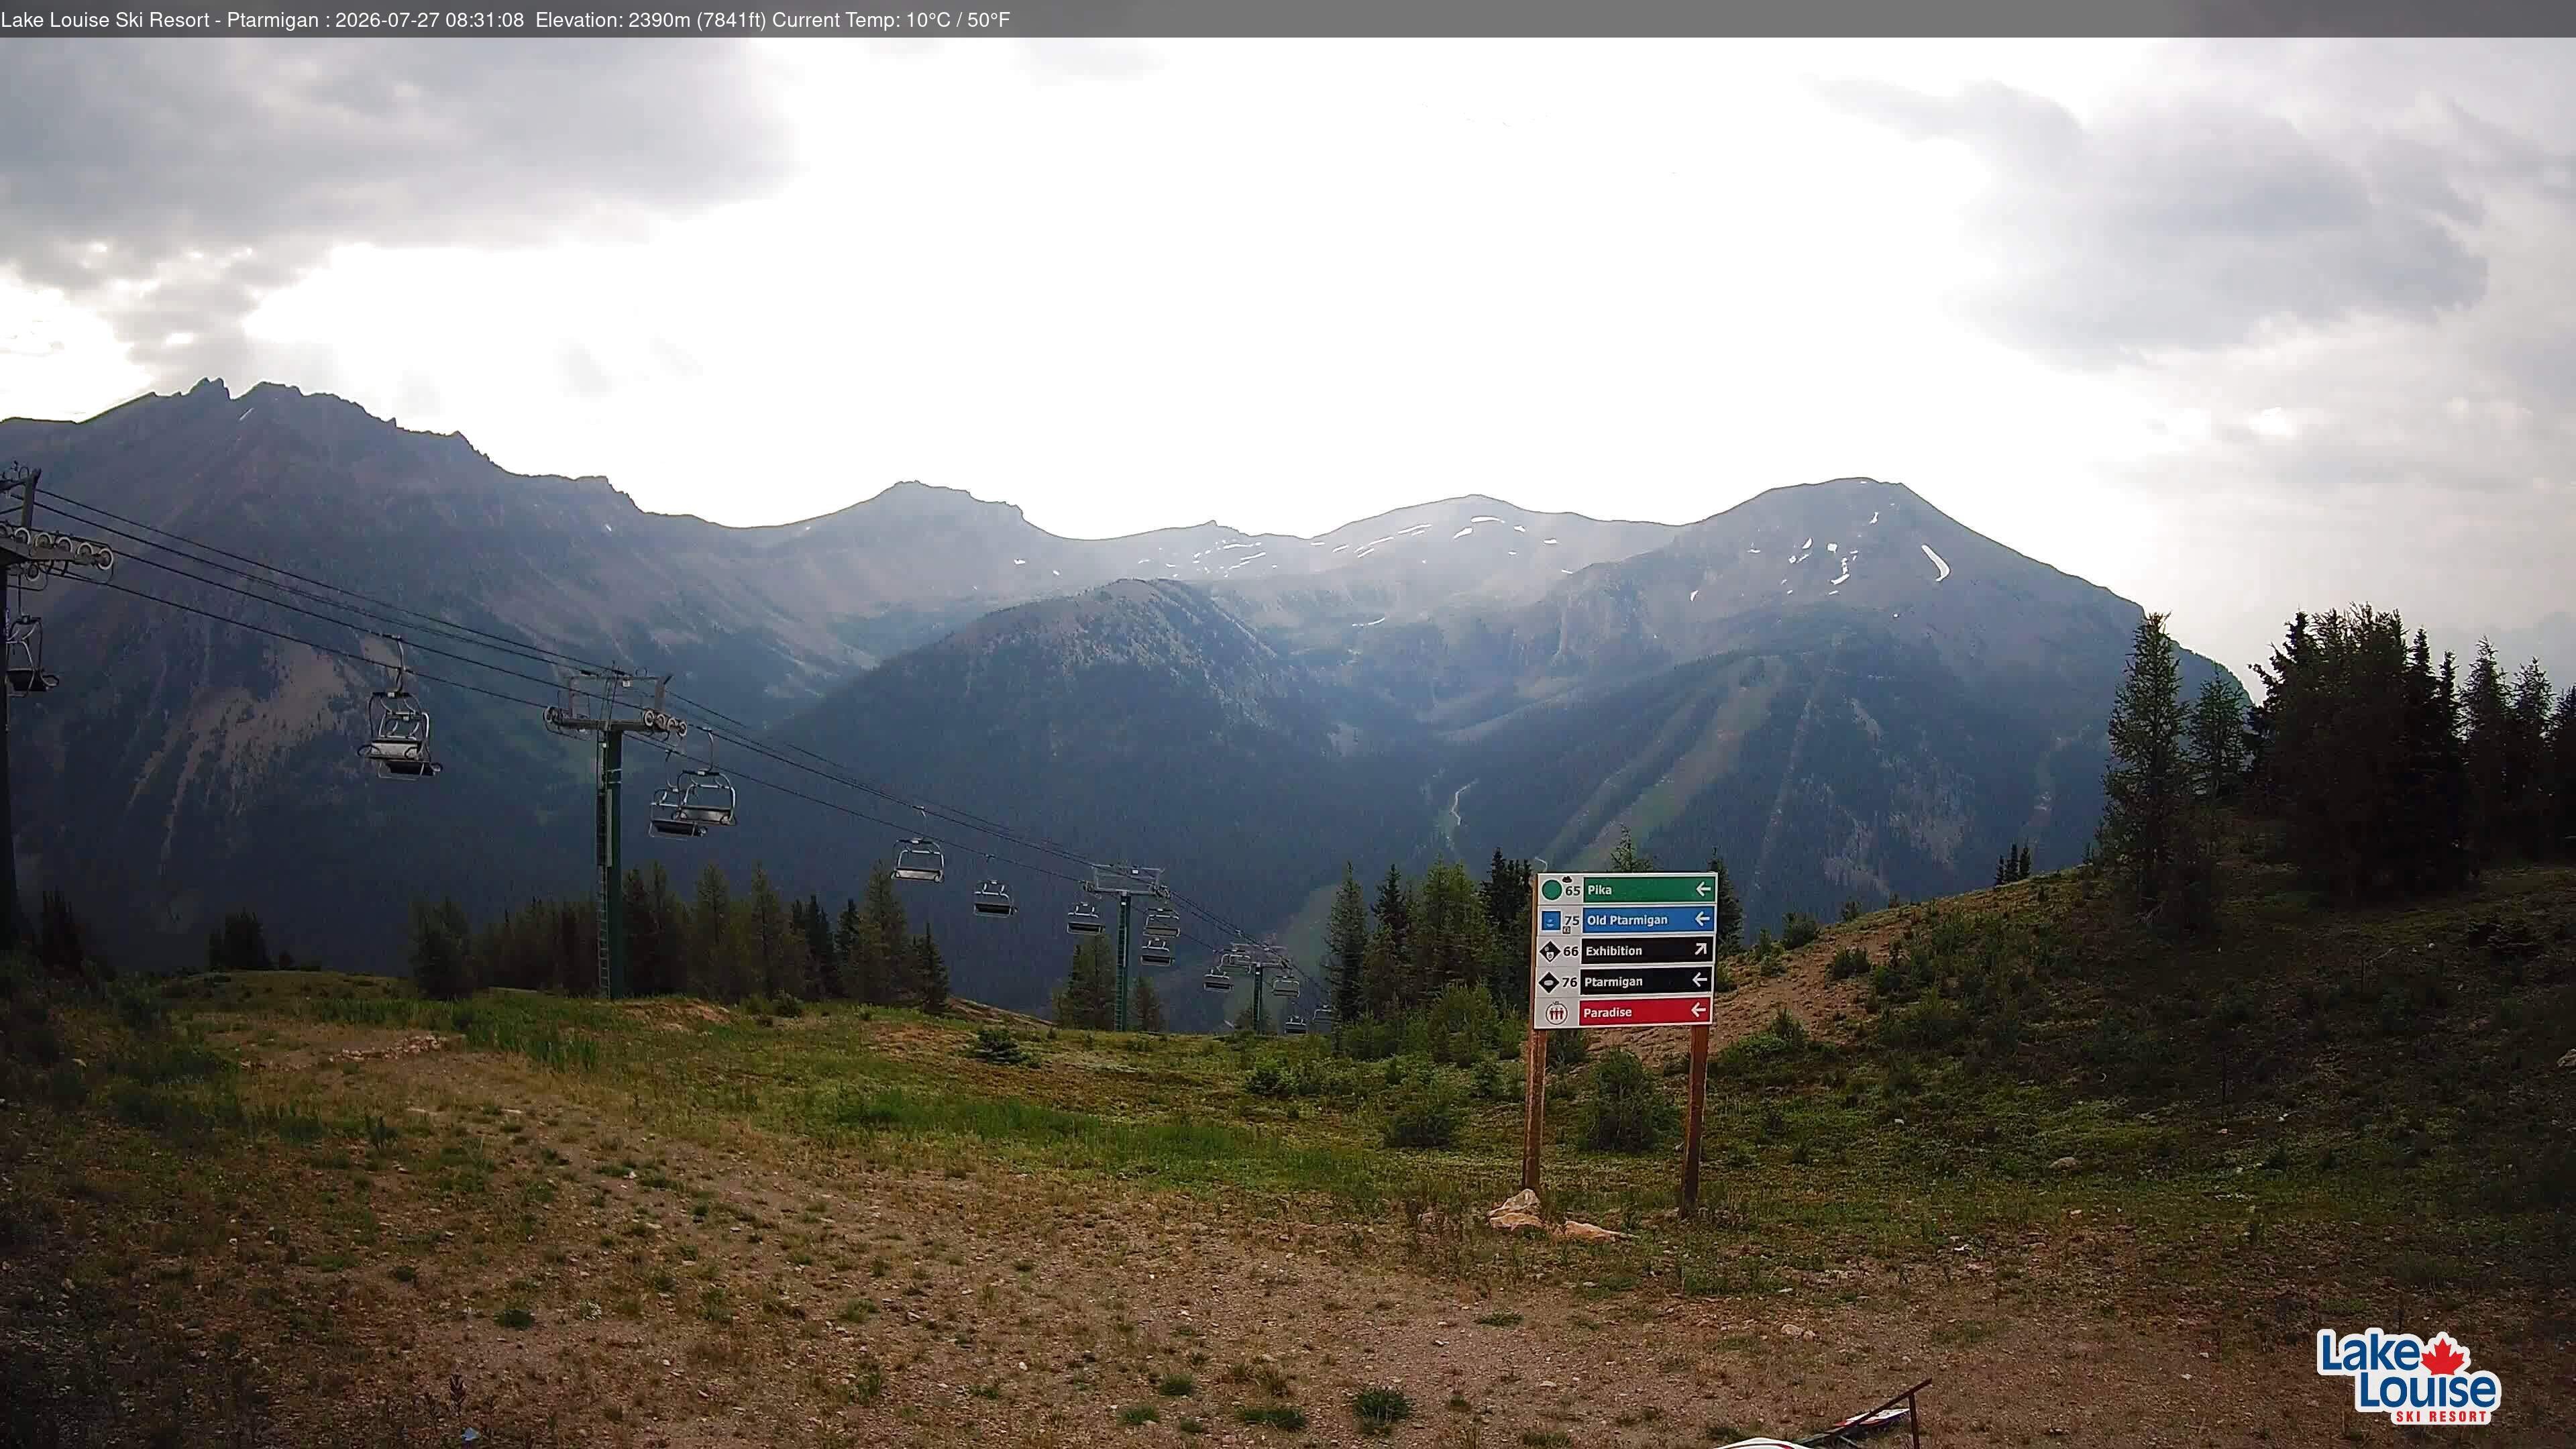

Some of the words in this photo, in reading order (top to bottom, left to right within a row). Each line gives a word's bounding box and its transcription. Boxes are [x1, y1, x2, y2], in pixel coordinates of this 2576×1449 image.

[1565, 885, 1580, 896] 65
[1587, 884, 1612, 896] Pika
[1564, 916, 1580, 926] 75
[1587, 915, 1607, 925] Old
[1609, 914, 1668, 927] Ptarmigan
[1563, 946, 1578, 957] 66
[1586, 945, 1643, 956] Exhibition
[1562, 977, 1578, 987] 76
[1585, 976, 1643, 989] Ptarmigan
[1583, 1007, 1632, 1018] Paradise
